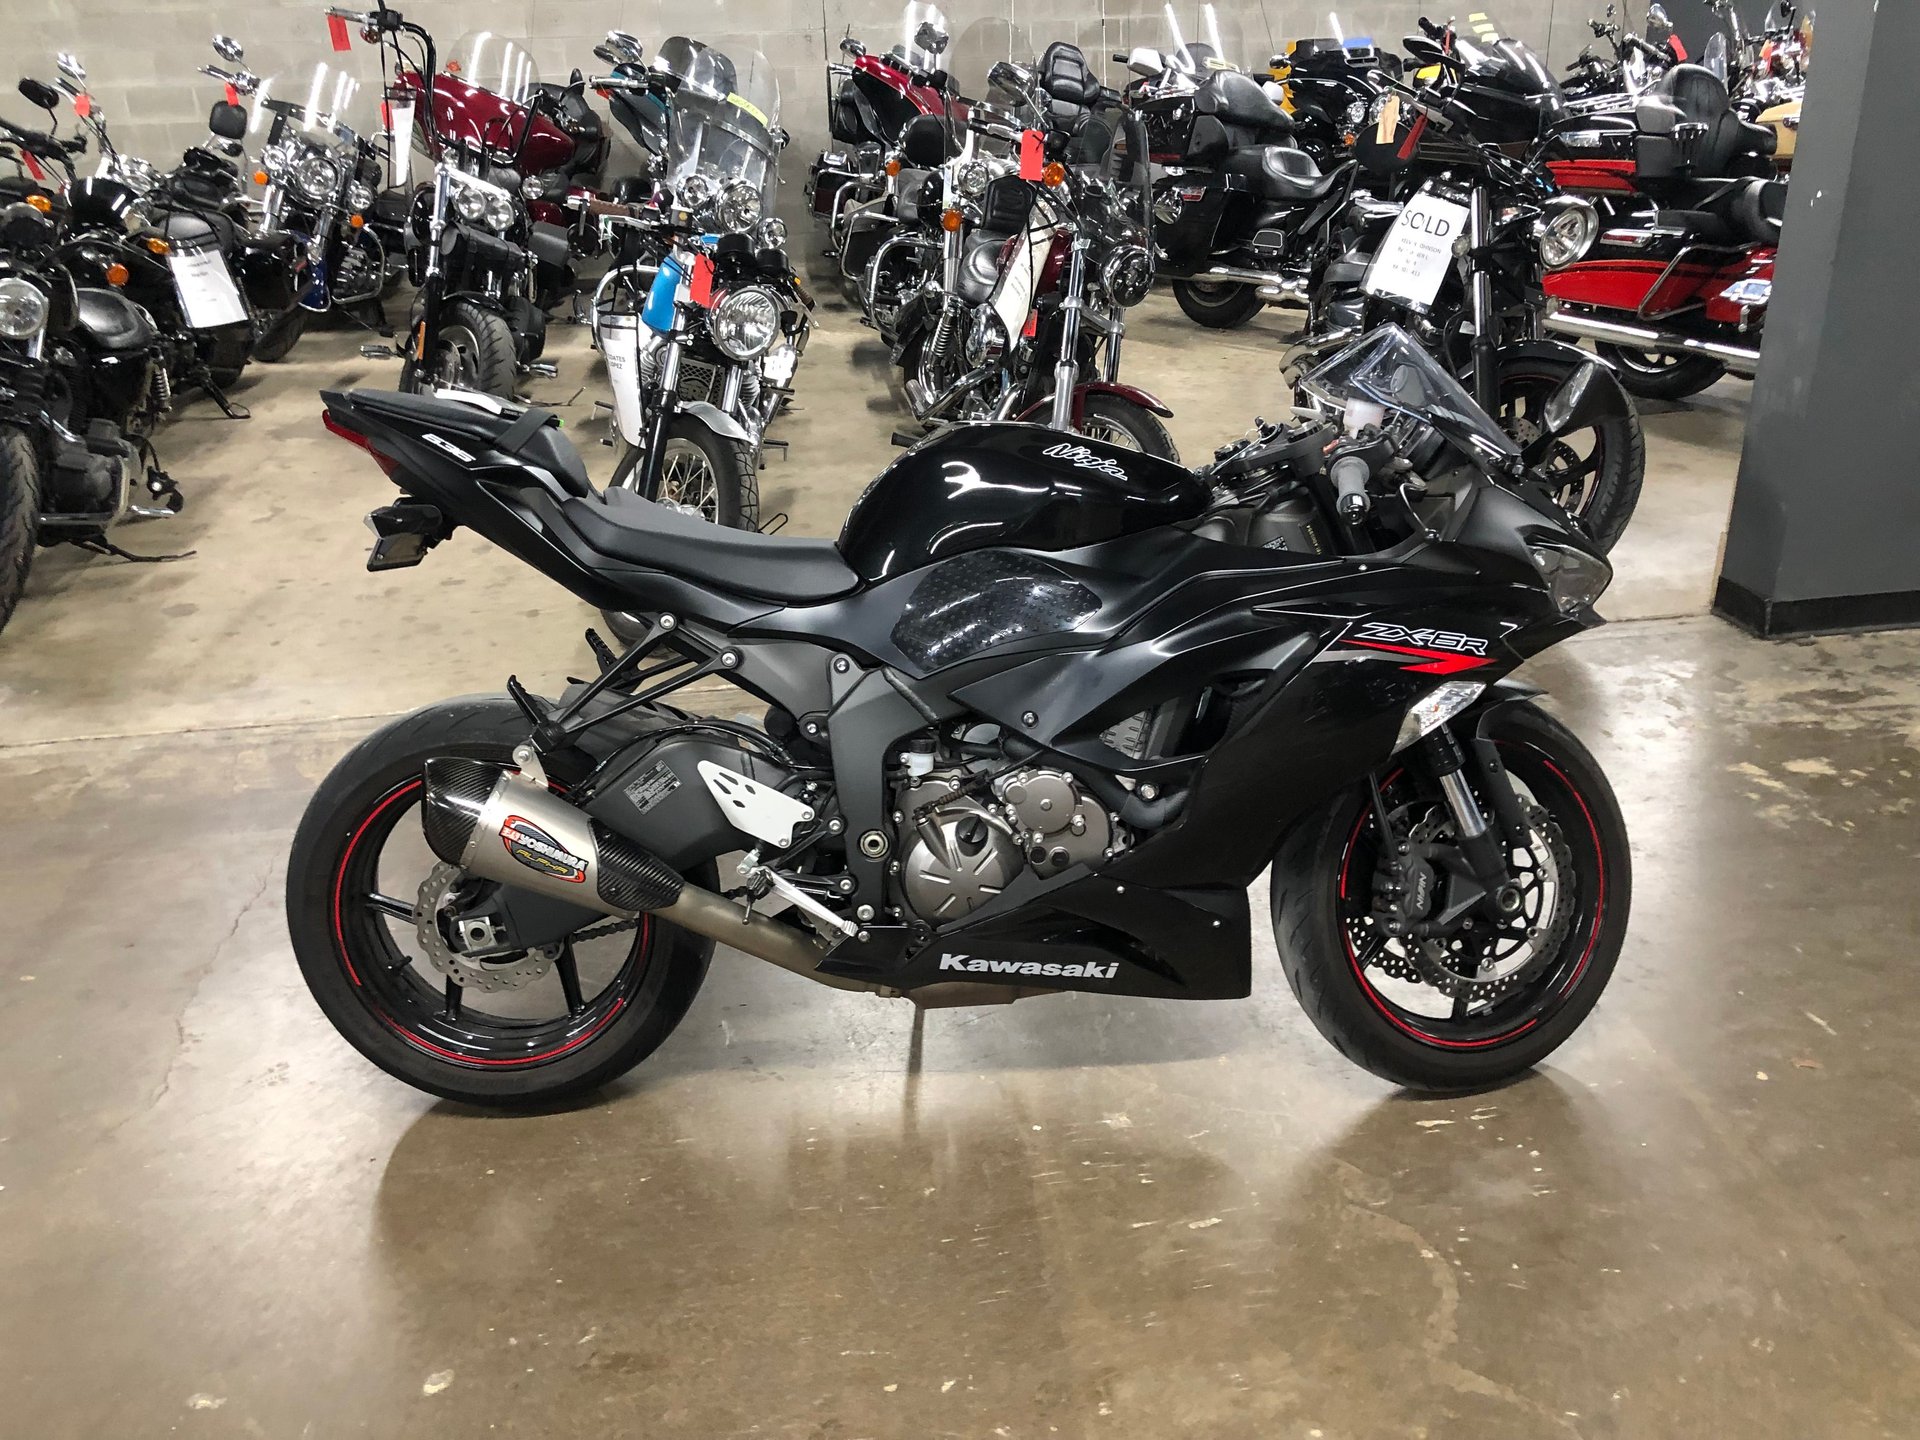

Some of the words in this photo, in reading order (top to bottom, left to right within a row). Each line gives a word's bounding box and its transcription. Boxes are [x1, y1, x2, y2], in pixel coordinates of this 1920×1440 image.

[1401, 209, 1450, 237] SOLD
[421, 433, 477, 463] 636
[1042, 443, 1128, 481] Ninja
[1354, 621, 1489, 656] ZX-6R
[515, 849, 569, 874] ALPHA
[519, 832, 588, 872] YOSHIMURA
[939, 953, 1120, 979] Kawasaki
